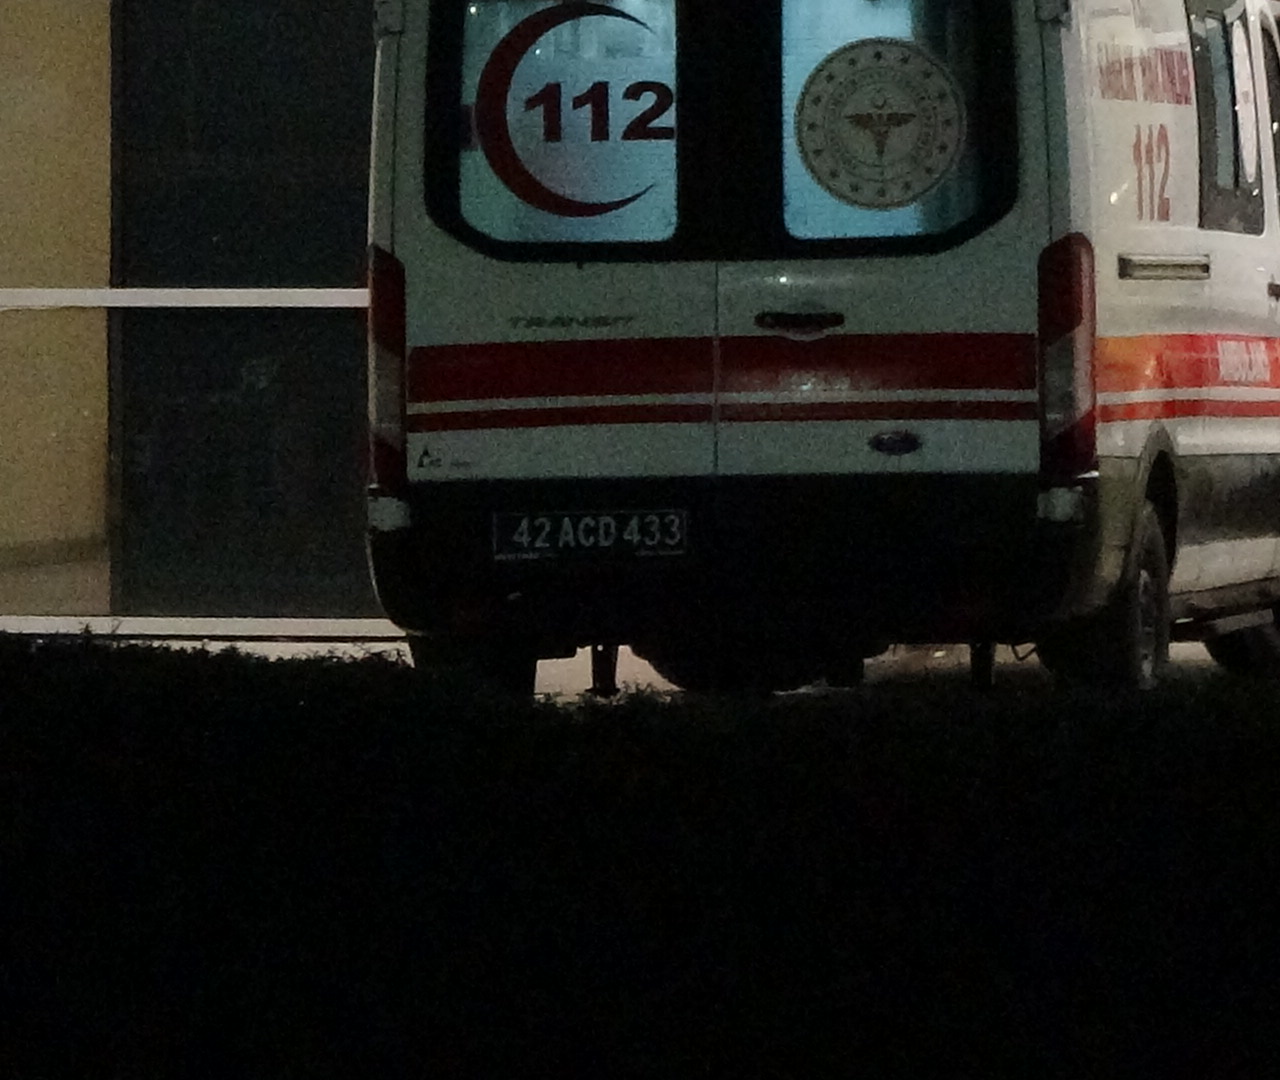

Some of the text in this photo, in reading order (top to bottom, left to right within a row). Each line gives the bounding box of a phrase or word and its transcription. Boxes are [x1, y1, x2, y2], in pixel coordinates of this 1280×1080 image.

[523, 80, 674, 143] 112
[1132, 123, 1170, 222] 112
[512, 514, 682, 548] 42 ACD 433
